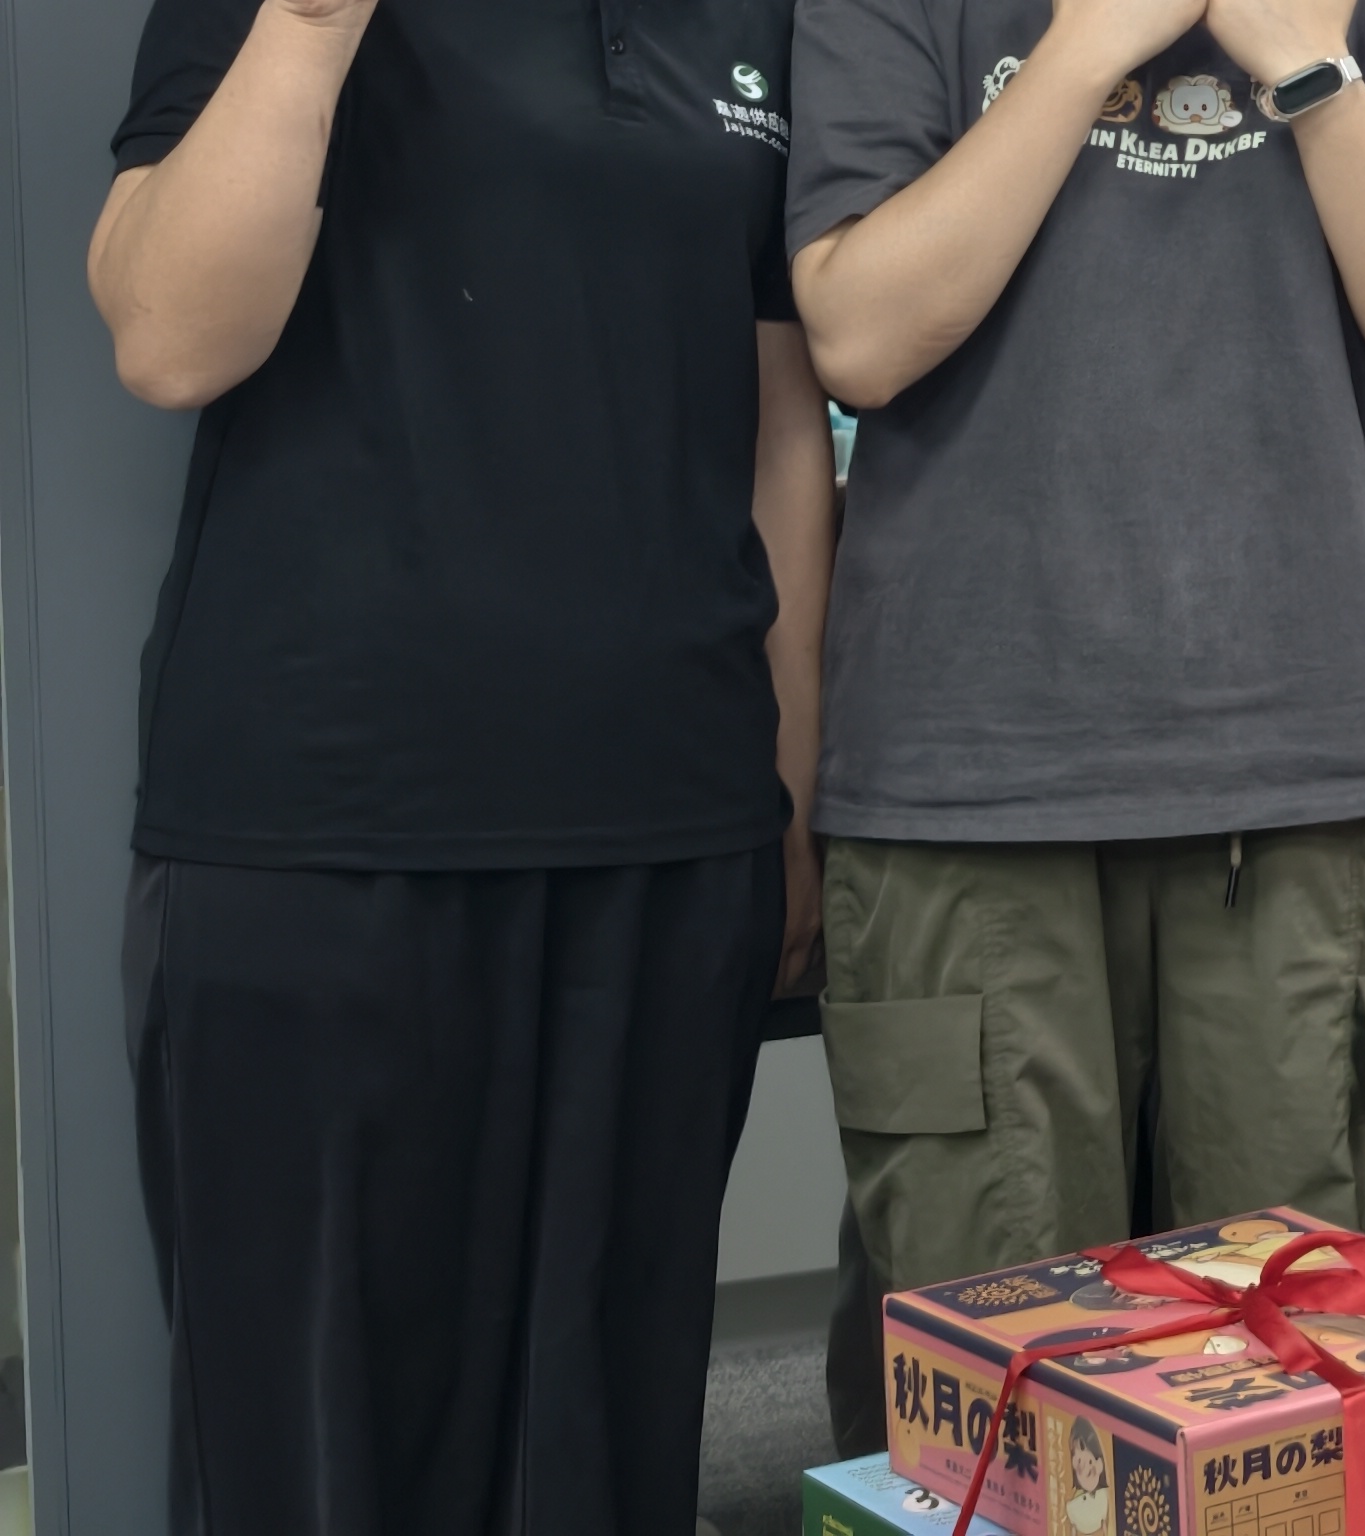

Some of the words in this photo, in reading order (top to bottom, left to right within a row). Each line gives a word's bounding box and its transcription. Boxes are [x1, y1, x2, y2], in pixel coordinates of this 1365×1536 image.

[892, 1352, 1039, 1485] 秋月の梨
[1203, 1425, 1344, 1496] 秋月の梨
